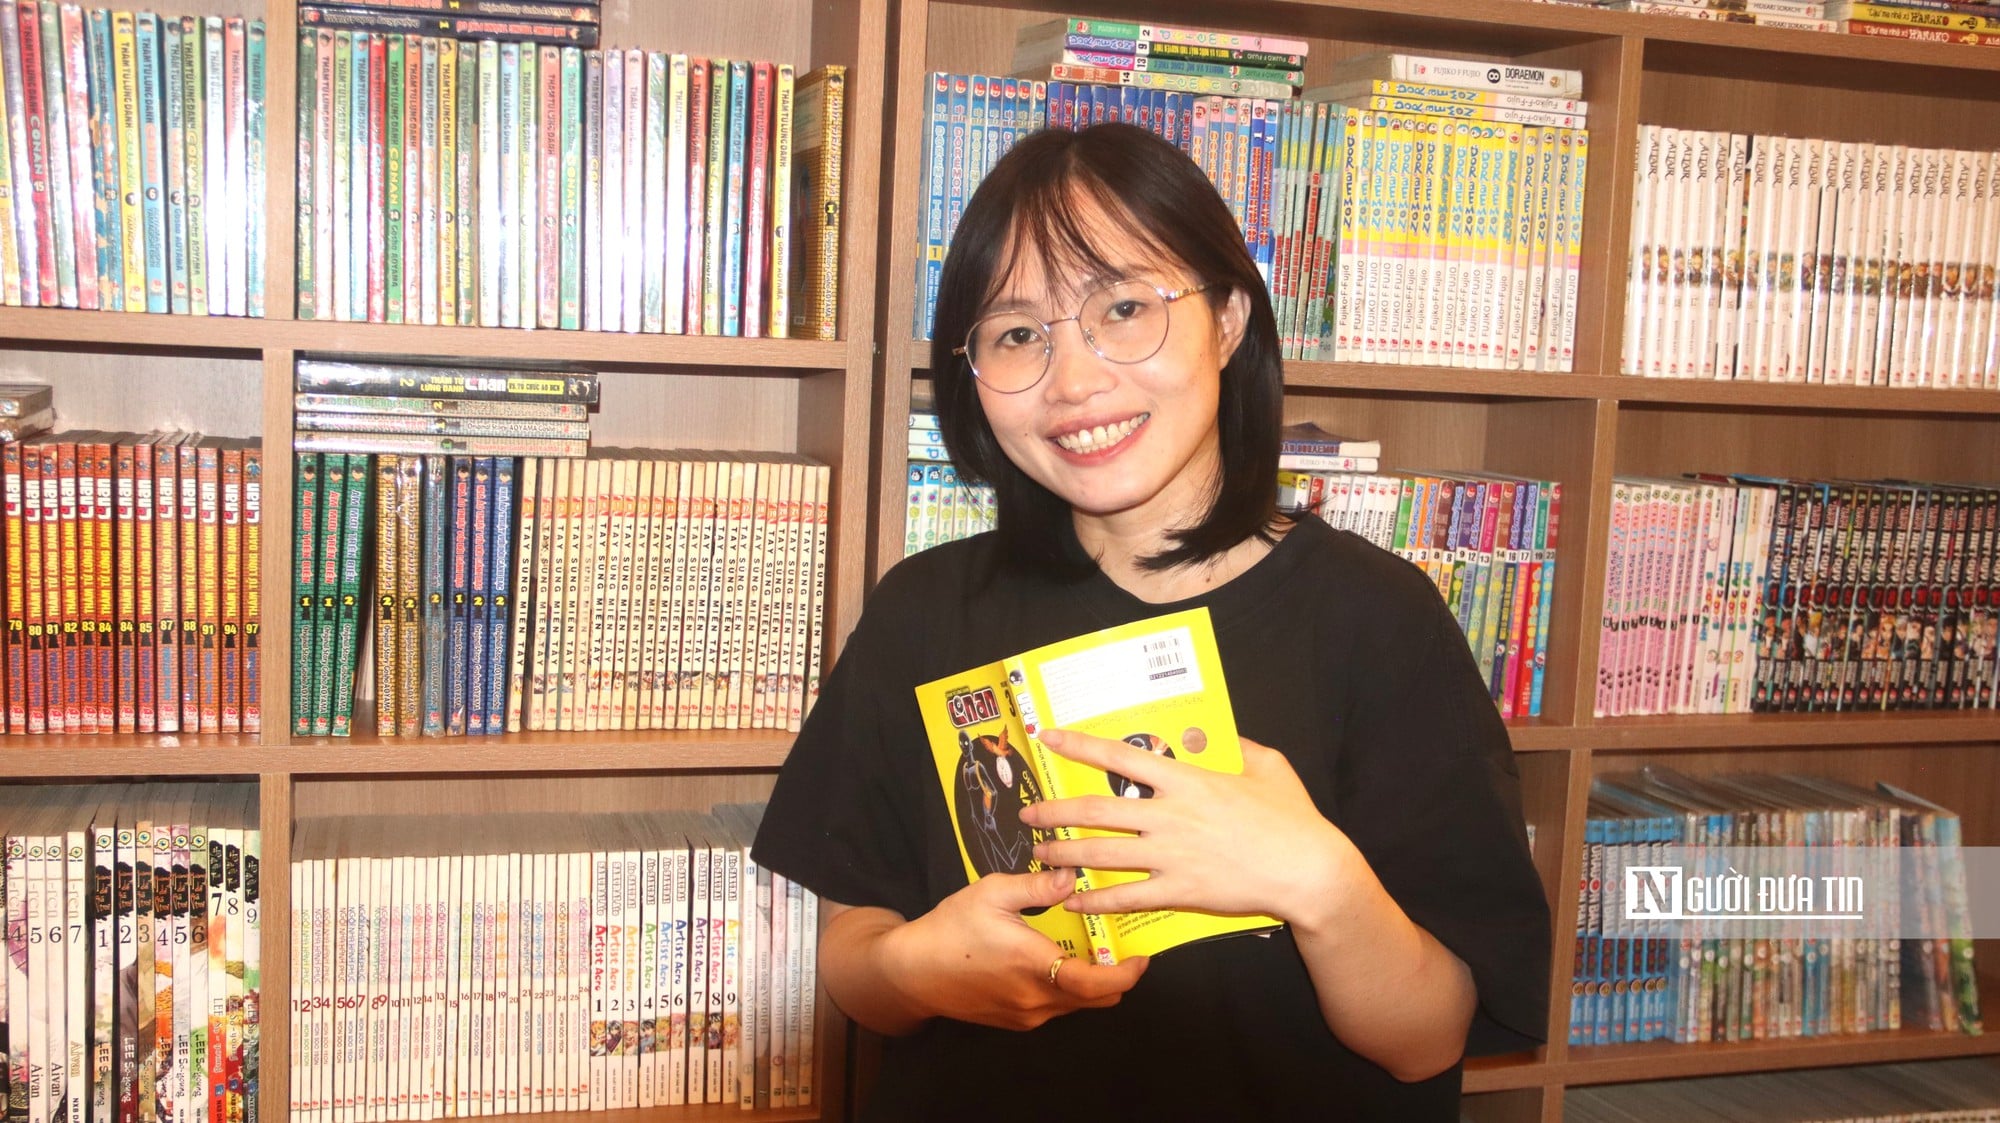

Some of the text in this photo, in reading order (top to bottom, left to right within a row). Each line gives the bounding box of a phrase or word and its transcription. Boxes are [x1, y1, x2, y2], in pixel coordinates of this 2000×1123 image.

[1910, 12, 1949, 25] HANAKO
[1909, 30, 1949, 42] HANAKO
[1137, 58, 1146, 68] 13
[1123, 72, 1131, 82] 14
[1434, 66, 1456, 76] FUJIKO
[1462, 69, 1481, 78] FUJIO
[1505, 68, 1544, 81] DORAEMON
[30, 115, 43, 175] CONAN
[390, 148, 401, 205] CONAN
[34, 182, 44, 191] 15
[1407, 552, 1413, 560] 3
[1421, 551, 1427, 560] 3
[1434, 551, 1439, 559] 8
[1446, 553, 1452, 562] 8
[1468, 552, 1476, 561] 12
[1521, 552, 1529, 561] 17
[302, 598, 310, 606] 1
[325, 598, 332, 606] 1
[344, 596, 353, 605] 2
[383, 597, 392, 606] 2
[9, 620, 22, 630] 79
[29, 625, 42, 635] 80
[46, 624, 58, 634] 81
[64, 623, 77, 632] 82
[82, 621, 95, 631] 83
[99, 622, 112, 632] 84
[120, 622, 133, 632] 84
[140, 623, 152, 633] 85
[161, 620, 174, 630] 87
[184, 621, 196, 631] 88
[202, 625, 214, 635] 91
[224, 625, 237, 634] 94
[246, 624, 258, 633] 97
[212, 893, 222, 916] 7
[228, 898, 238, 915] 8
[247, 909, 257, 923] 9
[11, 926, 21, 941] 4
[30, 928, 42, 943] 5
[49, 927, 62, 943] 6
[70, 925, 81, 943] 7
[99, 930, 108, 947] 1
[120, 925, 131, 943] 2
[139, 925, 149, 942] 3
[157, 928, 168, 945] 4
[175, 926, 187, 944] 5
[192, 926, 205, 943] 6
[645, 923, 656, 988] Artist Acro
[660, 922, 672, 987] Artist Acro
[675, 920, 686, 985] Artist Acro
[695, 918, 707, 982] Artist Acro
[711, 918, 723, 984] Artist Acro
[595, 925, 606, 991] Artist Acro
[610, 925, 621, 990] Artist Acro
[313, 997, 321, 1008] 3
[322, 998, 330, 1008] 4
[337, 997, 345, 1008] 5
[346, 997, 355, 1008] 6
[357, 995, 365, 1008] 7
[378, 995, 387, 1006] 9
[402, 999, 410, 1007] 11
[644, 997, 652, 1009] 4
[660, 995, 669, 1008] 5
[675, 993, 683, 1006] 6
[694, 992, 702, 1004] 7
[712, 993, 720, 1005] 8
[727, 993, 735, 1004] 9
[293, 1000, 298, 1011] 1
[302, 1000, 310, 1012] 2
[596, 1000, 601, 1012] 1
[611, 1000, 619, 1010] 2
[627, 1000, 635, 1011] 3
[178, 1035, 188, 1055] LEE
[71, 1041, 83, 1077] Aivan
[31, 1064, 44, 1099] Aivan
[52, 1063, 64, 1096] Aivan
